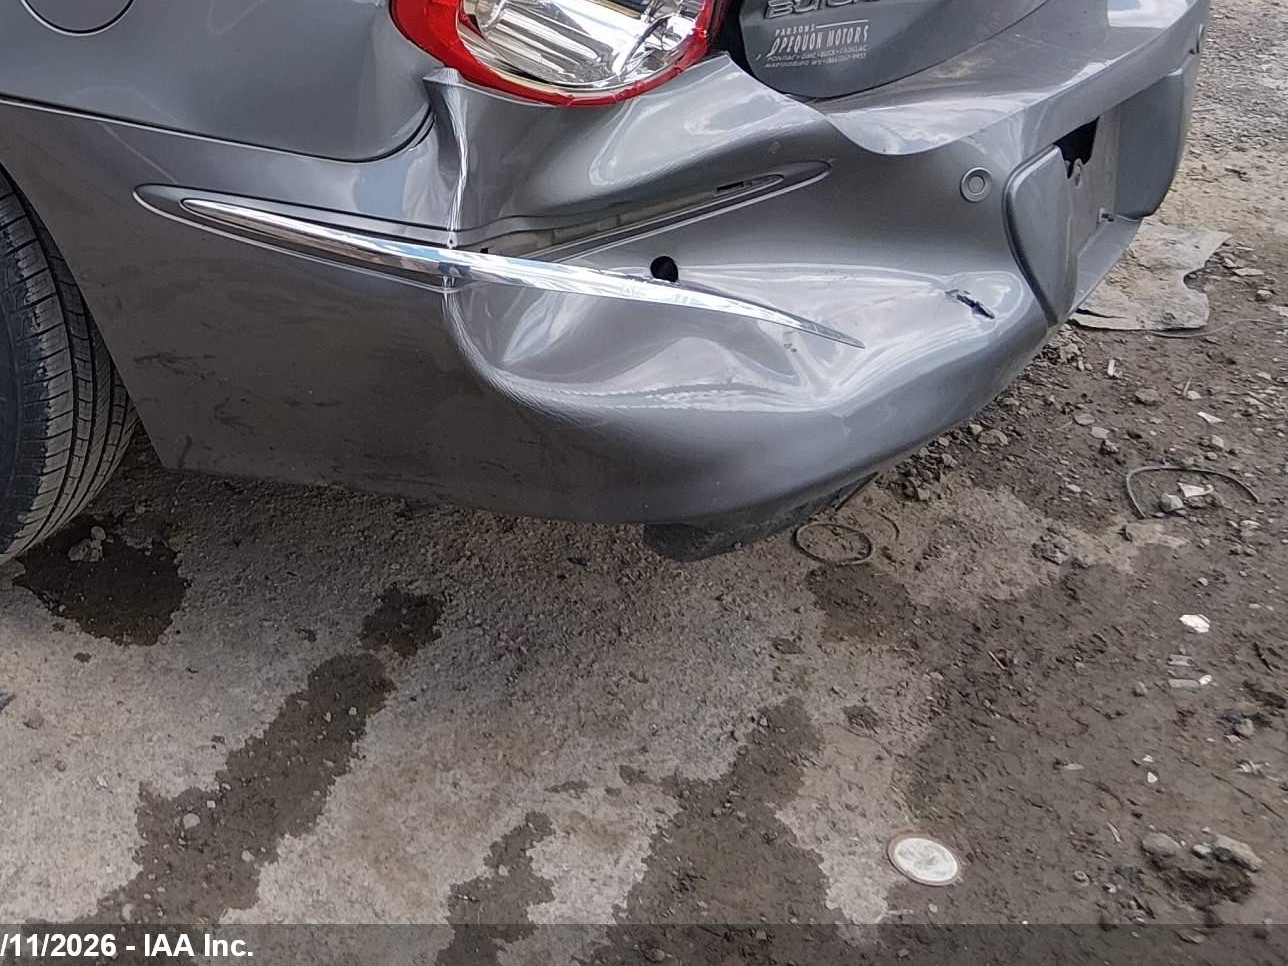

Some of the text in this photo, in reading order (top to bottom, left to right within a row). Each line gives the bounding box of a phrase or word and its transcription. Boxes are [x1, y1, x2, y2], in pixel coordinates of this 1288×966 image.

[775, 23, 816, 36] PARSONS
[766, 25, 870, 57] OPEQUON MOTORS
